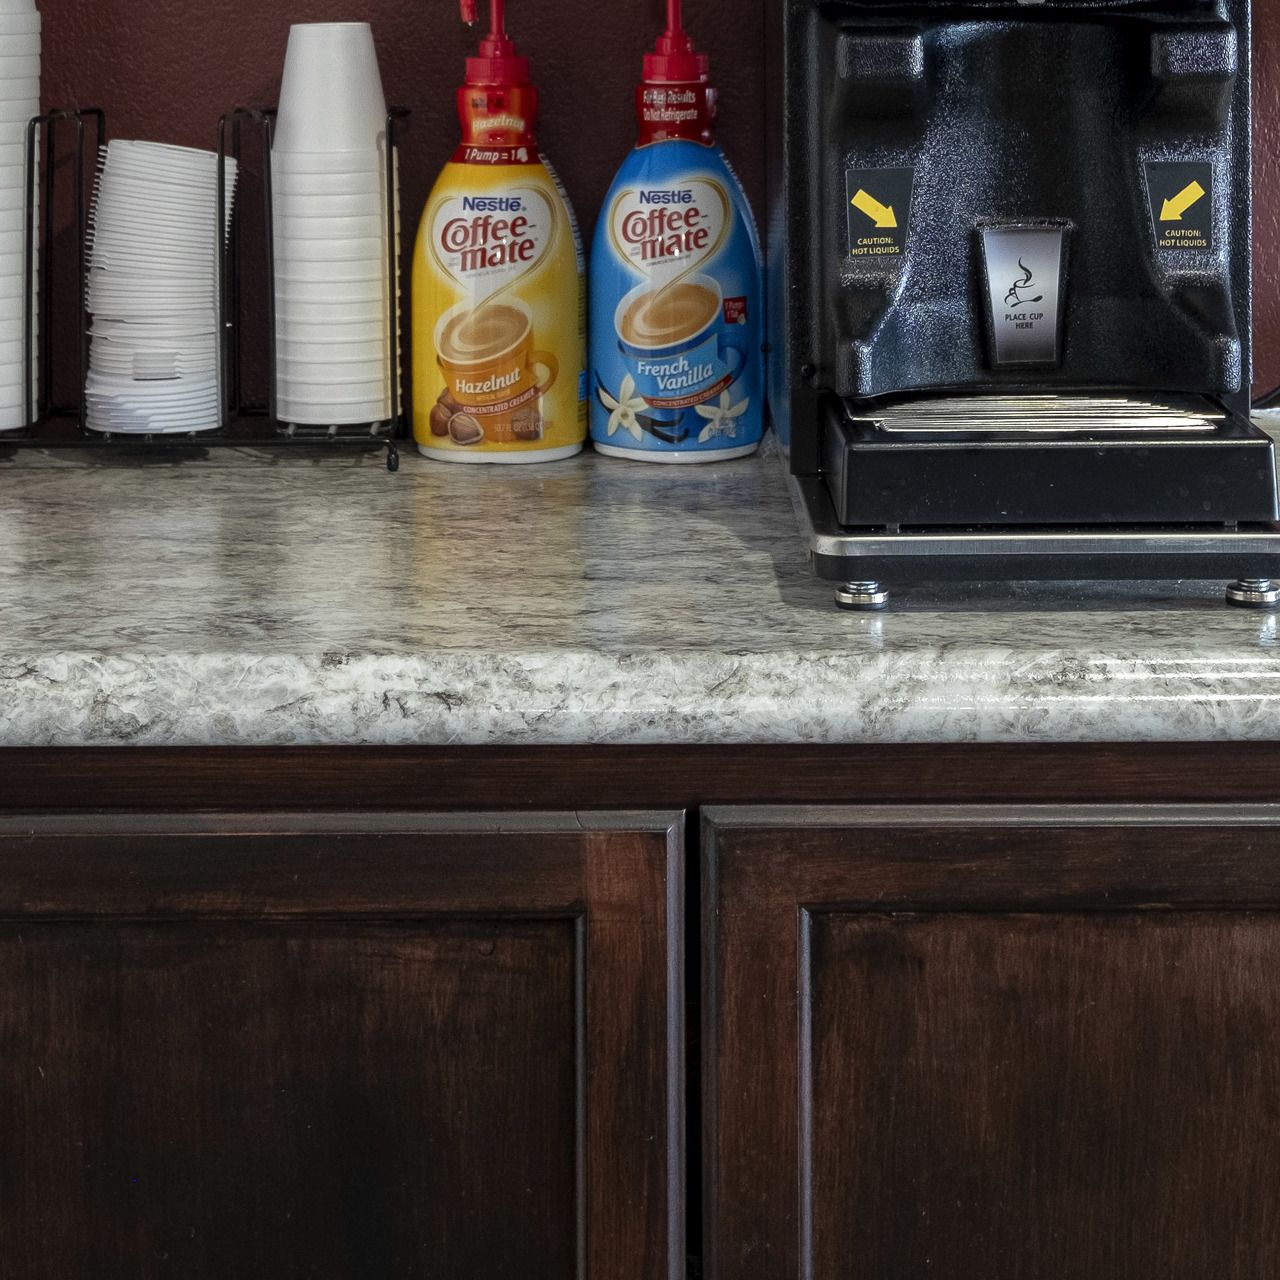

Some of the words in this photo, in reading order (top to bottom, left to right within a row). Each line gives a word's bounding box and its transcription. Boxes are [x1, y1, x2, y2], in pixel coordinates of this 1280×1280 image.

[668, 90, 696, 104] Results
[661, 107, 698, 124] Refrigerate
[470, 149, 499, 163] Pump
[1165, 229, 1201, 237] CAUTION:
[641, 228, 708, 260] mate
[857, 237, 894, 245] CAUTION:
[1176, 239, 1207, 247] LIQUIDS
[460, 239, 535, 272] mate
[869, 246, 900, 254] LIQUIDS
[1005, 313, 1026, 321] PLACE
[638, 357, 689, 377] French
[456, 368, 520, 393] Hazelnut
[656, 363, 713, 391] Vanilla
